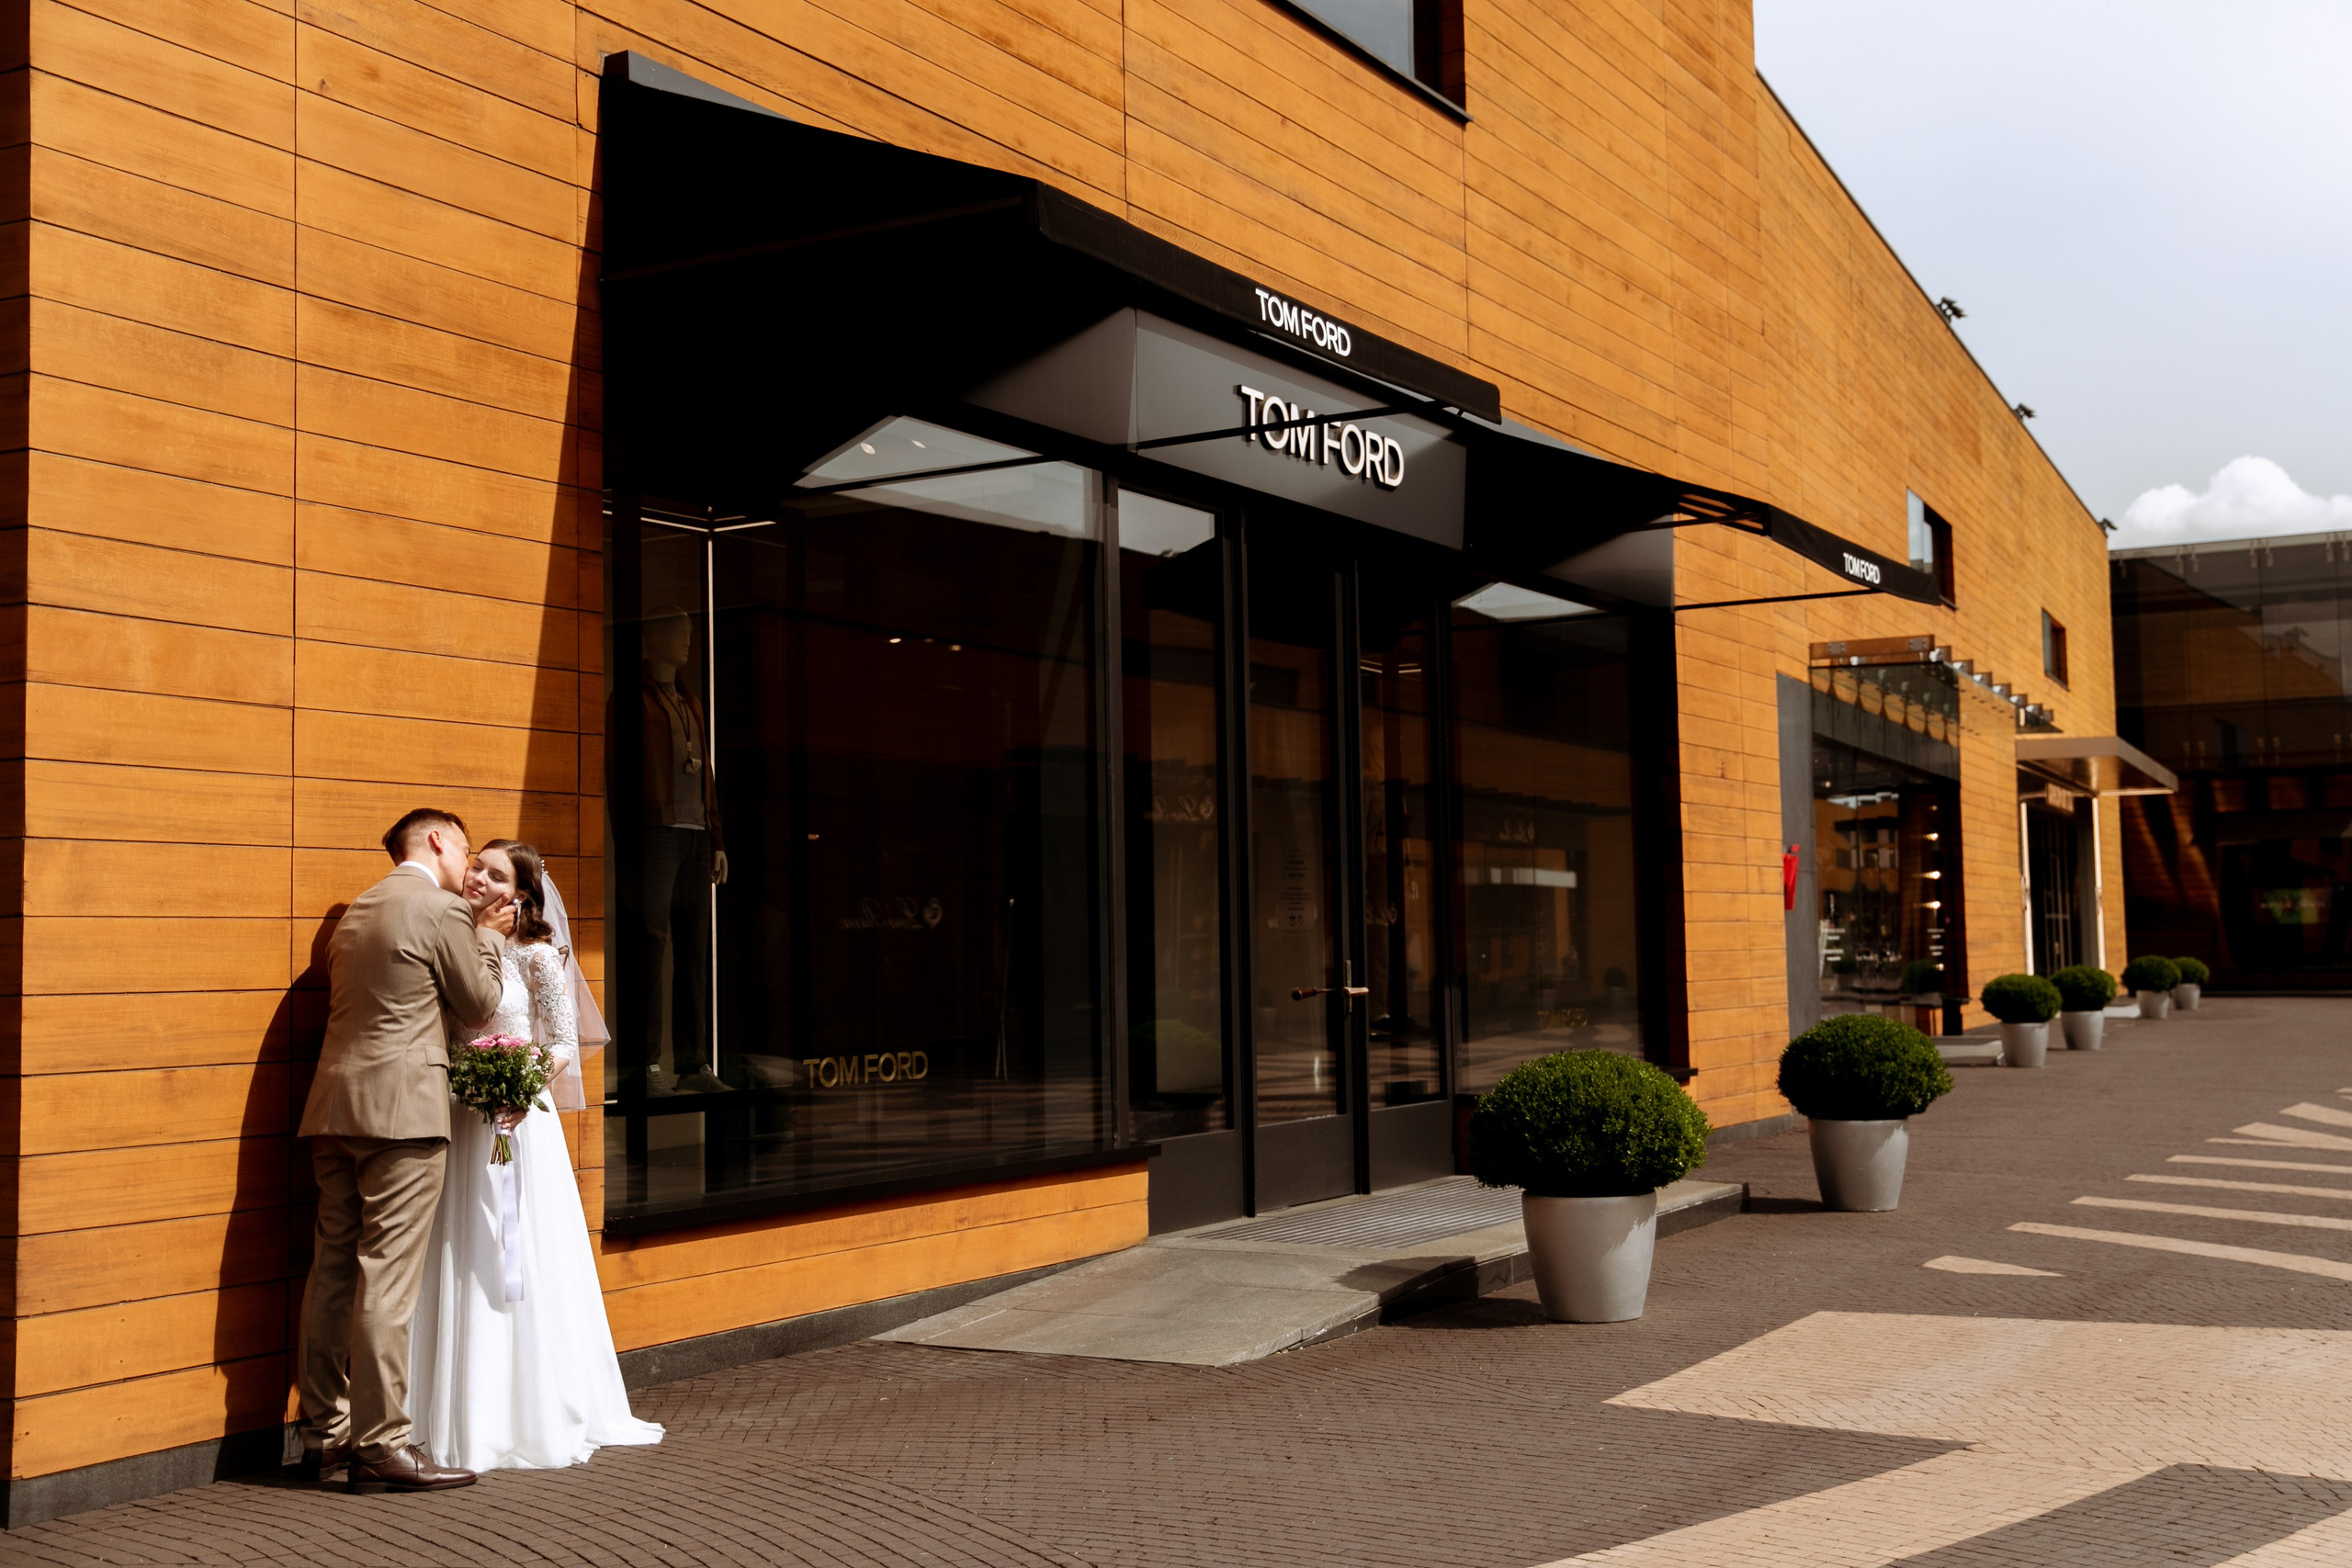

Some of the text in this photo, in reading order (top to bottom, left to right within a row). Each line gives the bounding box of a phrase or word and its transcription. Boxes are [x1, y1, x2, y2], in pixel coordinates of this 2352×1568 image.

[1255, 288, 1351, 357] TOM FORD
[1239, 384, 1406, 487] TOM FORD
[1843, 552, 1880, 584] TOM FORD
[803, 1051, 929, 1089] TOM FORD
